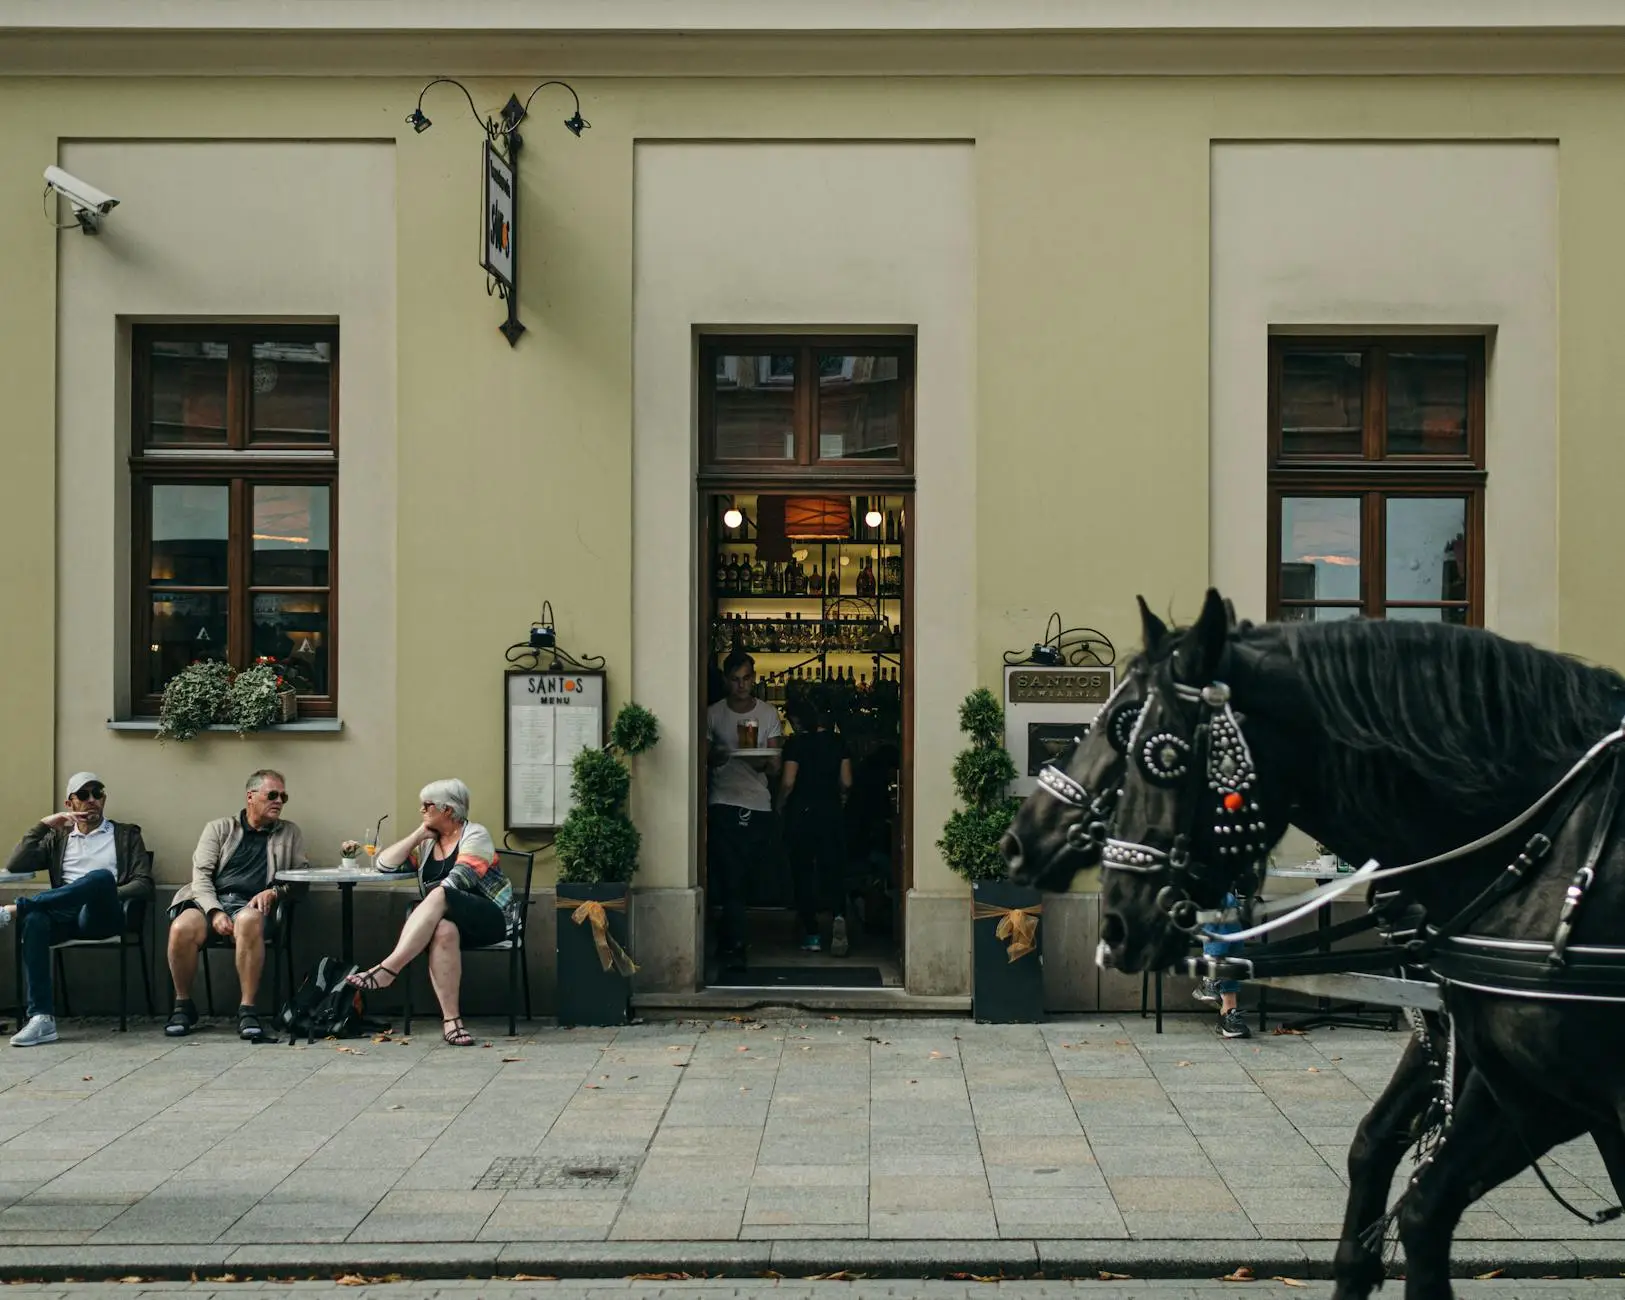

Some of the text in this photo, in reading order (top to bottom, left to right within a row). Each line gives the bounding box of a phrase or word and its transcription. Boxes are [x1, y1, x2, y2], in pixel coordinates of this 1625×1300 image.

[528, 676, 583, 694] SANTOS
[1016, 675, 1102, 687] SANTOS
[540, 696, 570, 705] MENU
